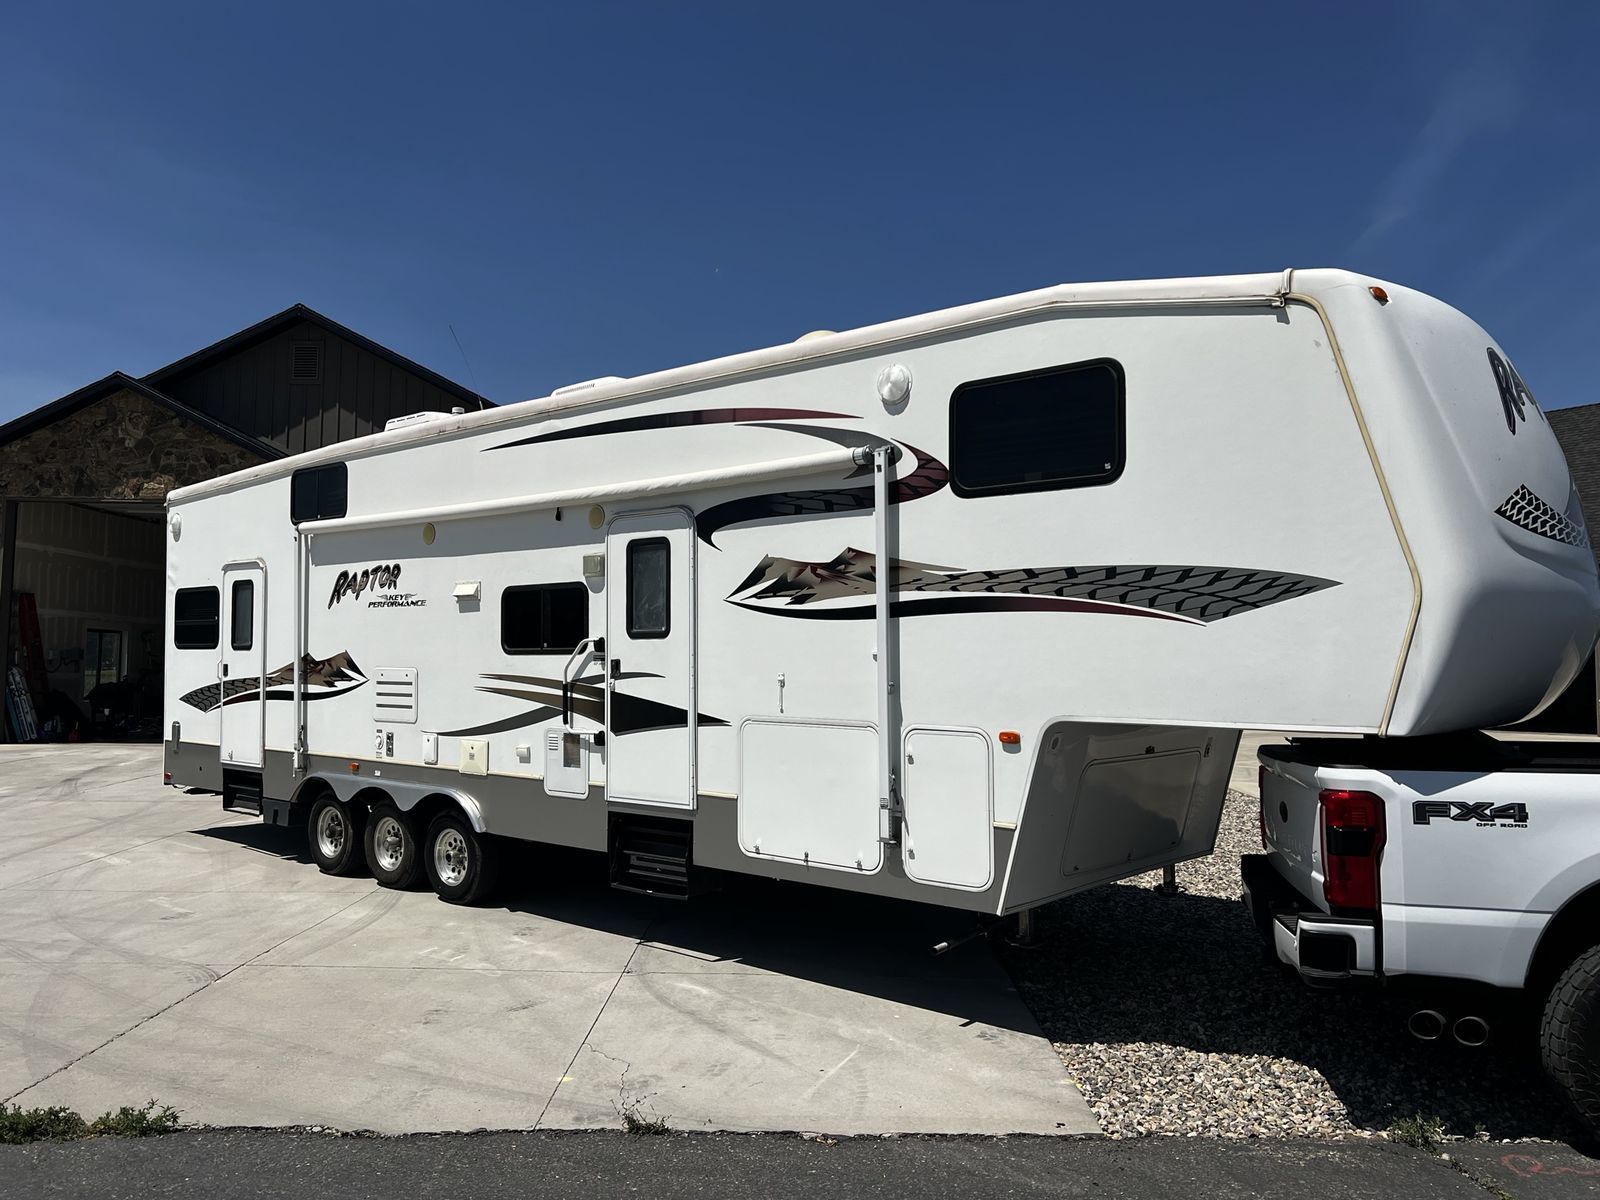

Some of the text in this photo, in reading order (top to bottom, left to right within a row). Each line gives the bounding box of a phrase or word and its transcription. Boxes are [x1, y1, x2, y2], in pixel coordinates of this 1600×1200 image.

[327, 563, 401, 610] RAPTOR
[367, 599, 427, 609] PERFORMANCE
[1412, 800, 1529, 825] FX4
